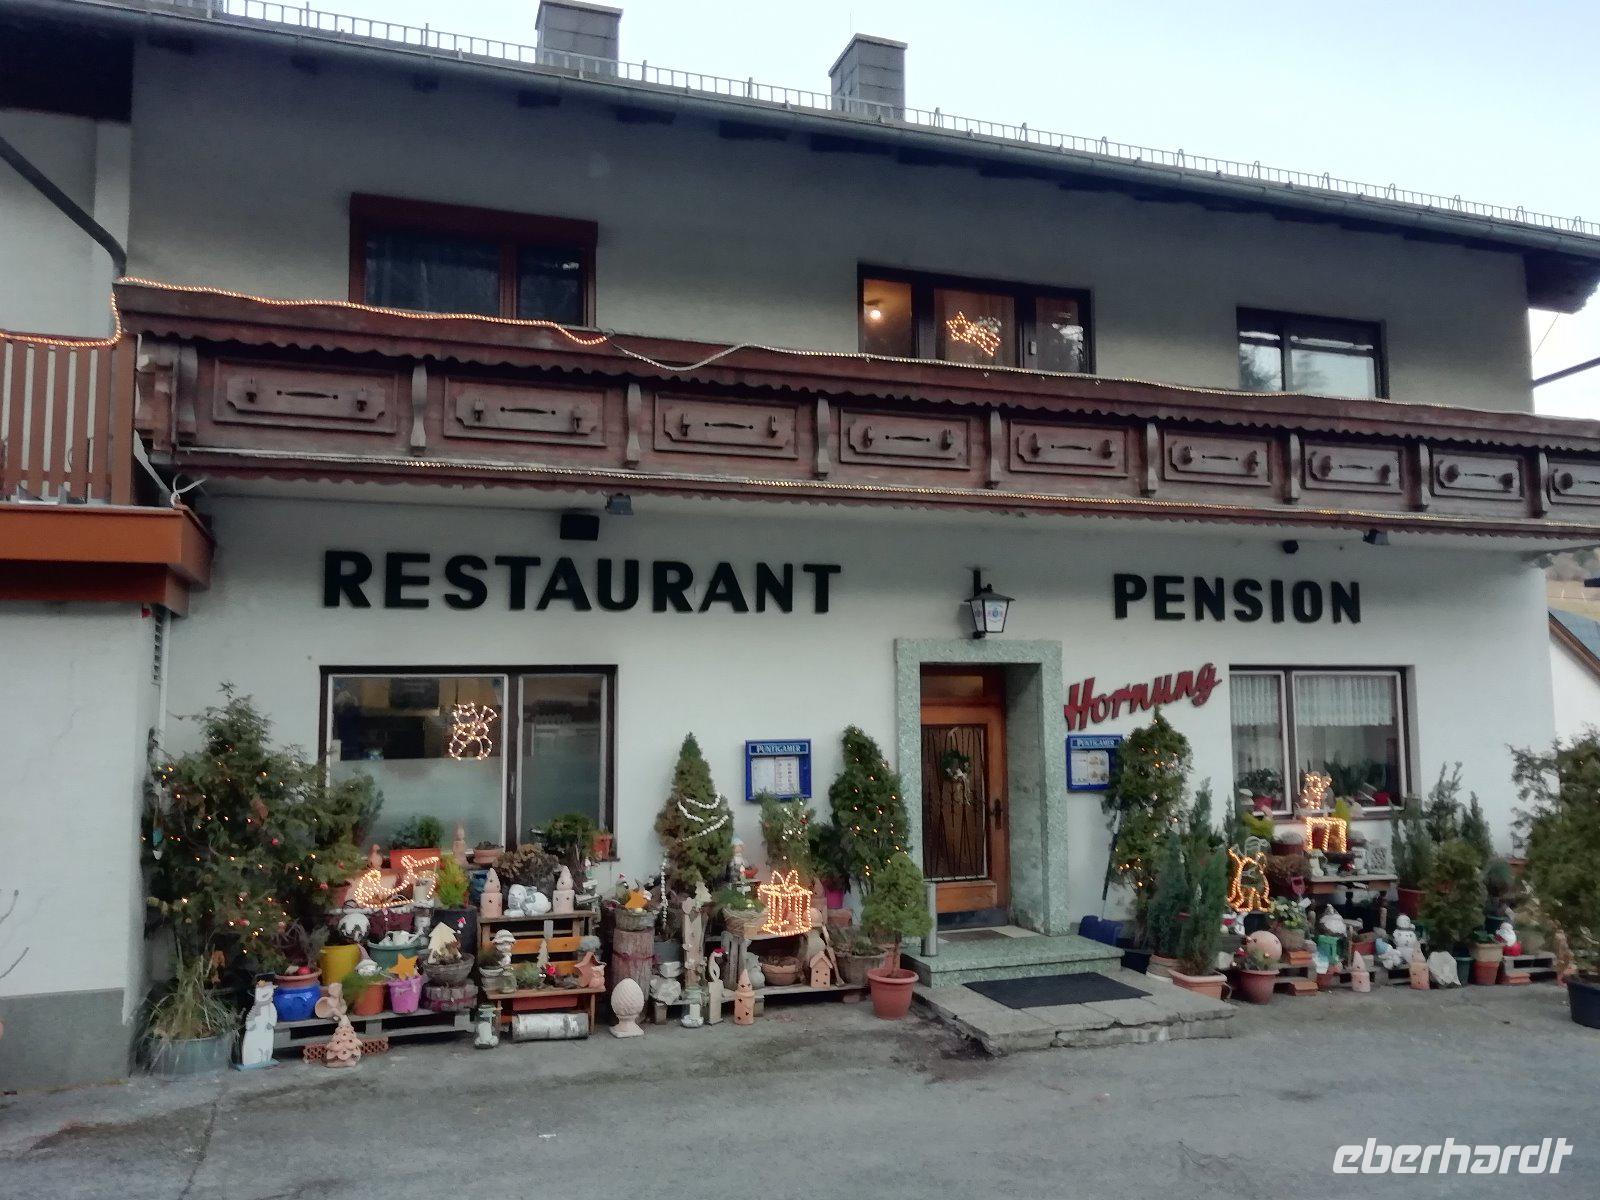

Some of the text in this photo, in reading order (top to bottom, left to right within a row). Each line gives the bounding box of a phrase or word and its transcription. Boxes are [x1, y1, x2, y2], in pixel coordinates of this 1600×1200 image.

[323, 549, 842, 614] RESTAURANT
[1112, 572, 1362, 624] PENSION
[1064, 662, 1222, 731] Hornung
